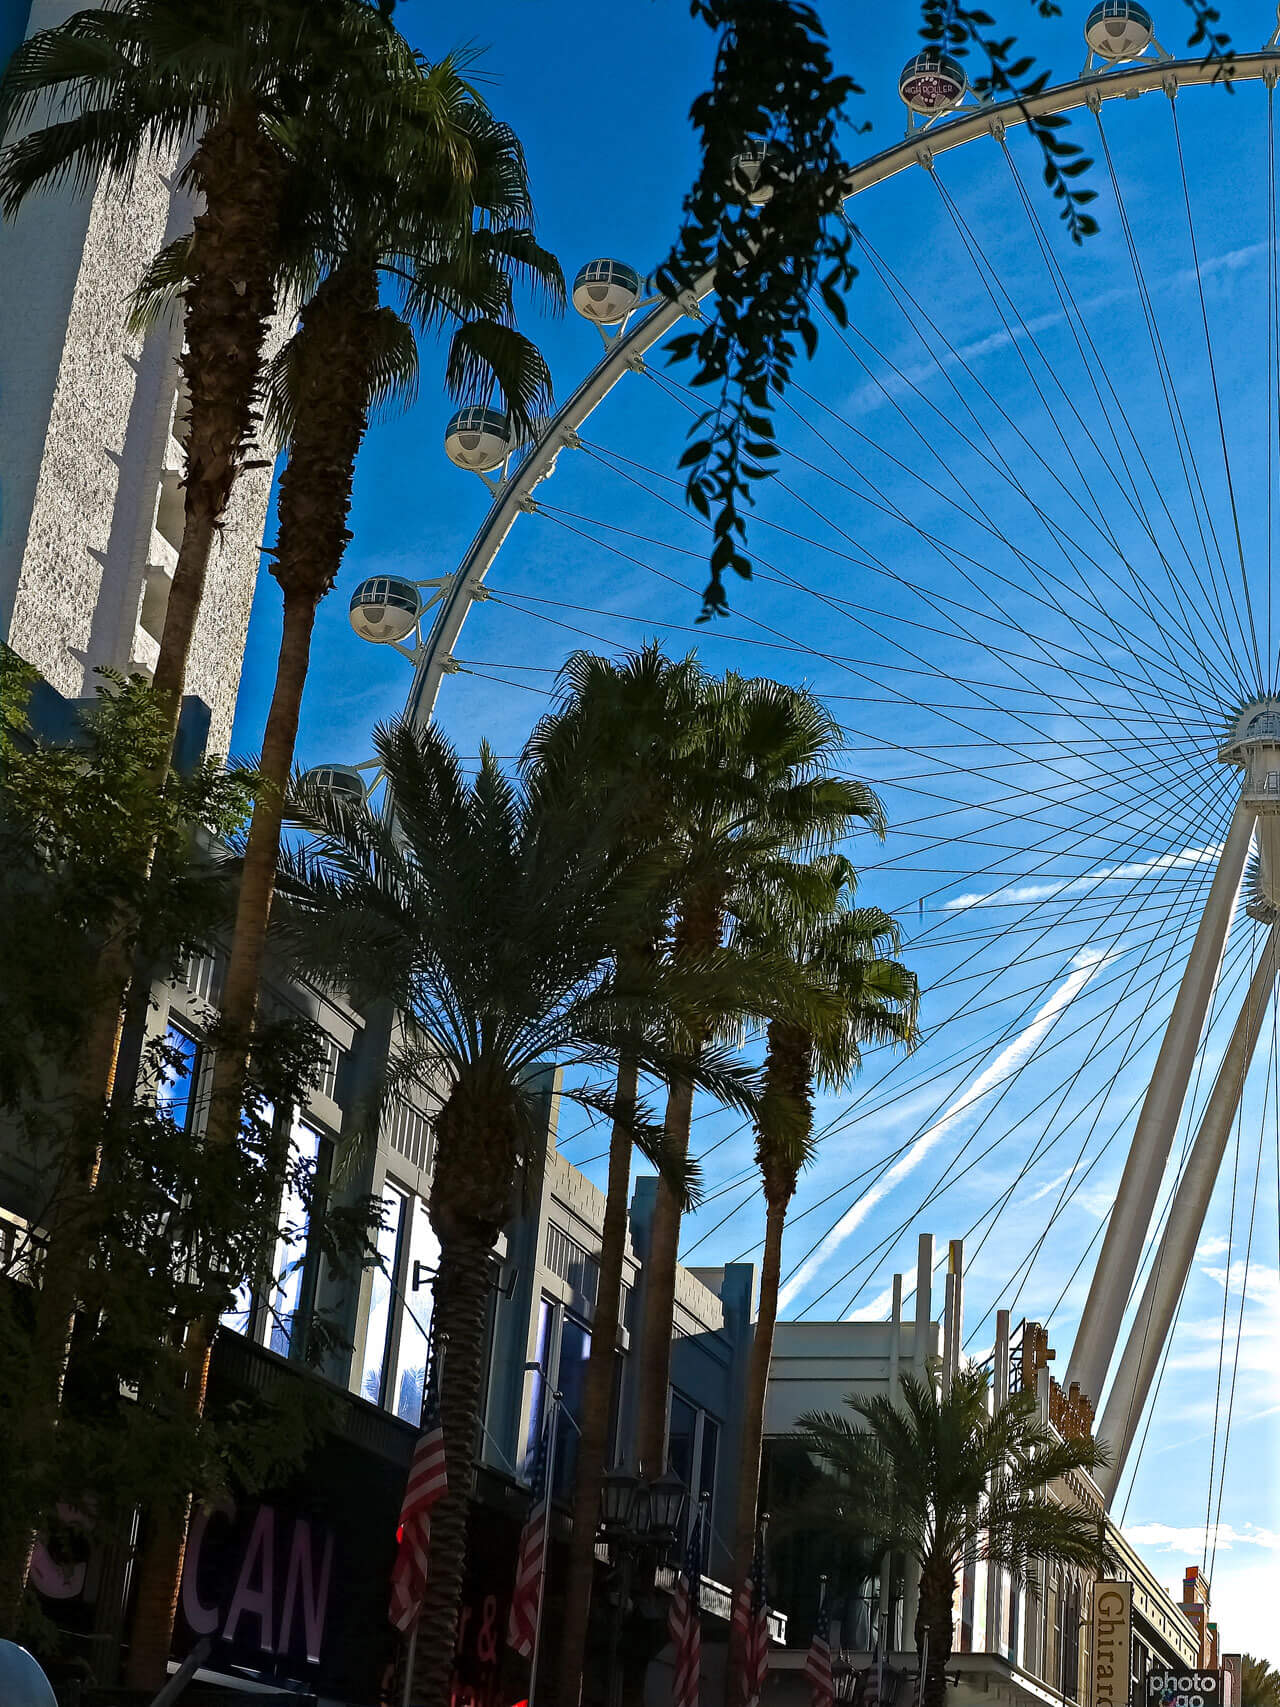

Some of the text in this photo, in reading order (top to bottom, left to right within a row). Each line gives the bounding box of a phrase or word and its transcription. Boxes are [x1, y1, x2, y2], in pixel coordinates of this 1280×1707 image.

[922, 84, 953, 94] ROLLER
[1095, 1590, 1127, 1707] Ghirar
[1149, 1671, 1217, 1697] photo
